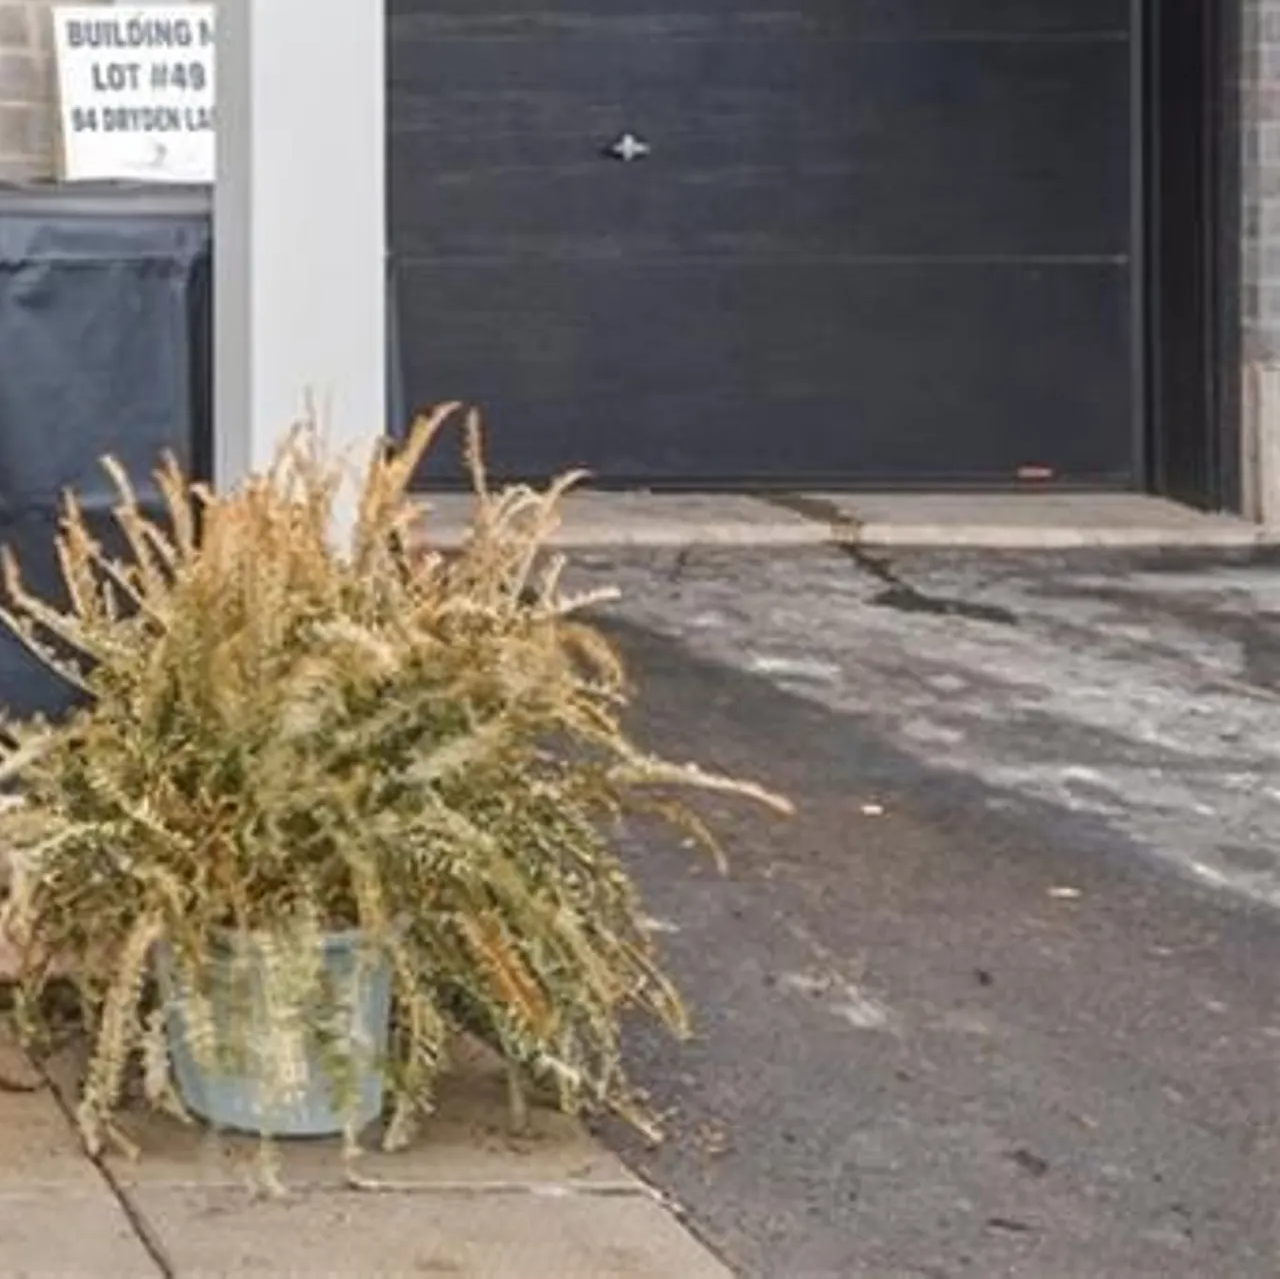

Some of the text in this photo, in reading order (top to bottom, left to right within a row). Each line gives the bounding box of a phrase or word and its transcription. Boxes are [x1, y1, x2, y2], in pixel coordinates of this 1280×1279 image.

[67, 20, 192, 47] BUILDING
[92, 63, 206, 90] LOT #49
[185, 106, 216, 132] LA
